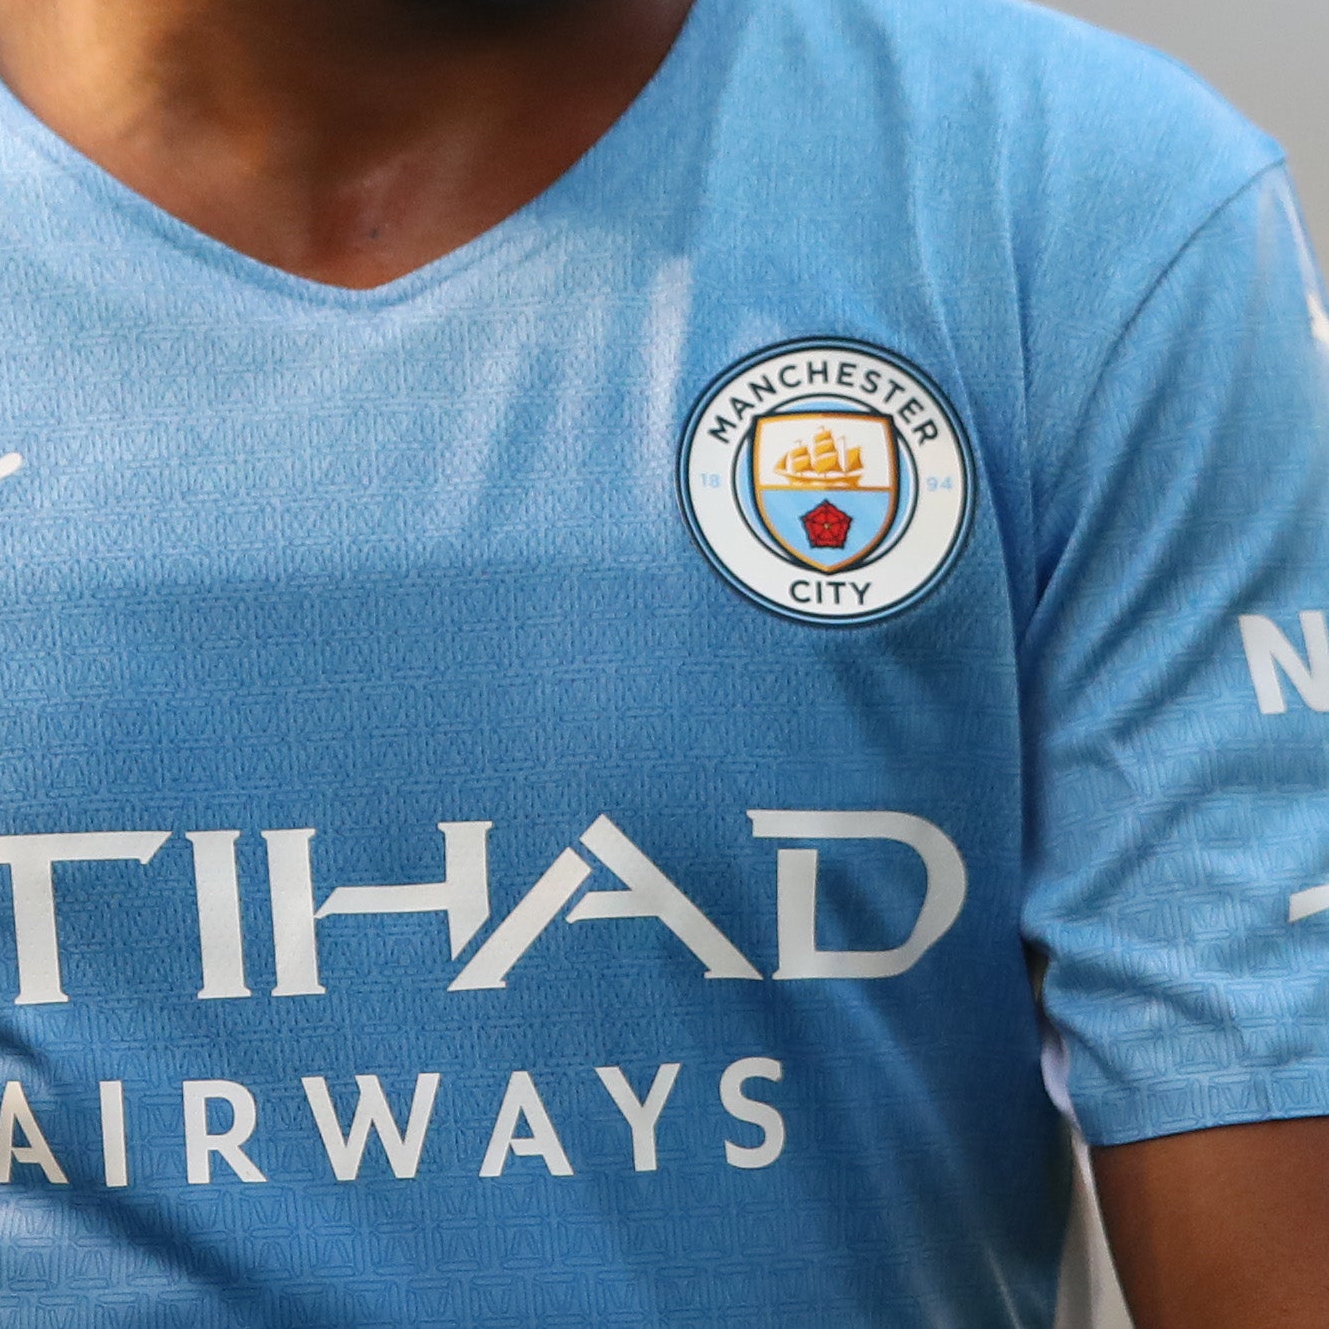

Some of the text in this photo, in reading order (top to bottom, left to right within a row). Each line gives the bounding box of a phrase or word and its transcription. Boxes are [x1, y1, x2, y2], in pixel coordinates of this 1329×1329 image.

[708, 361, 939, 446] MANCHESTER
[700, 474, 720, 490] 18
[926, 478, 953, 492] 94
[789, 580, 872, 605] CITY
